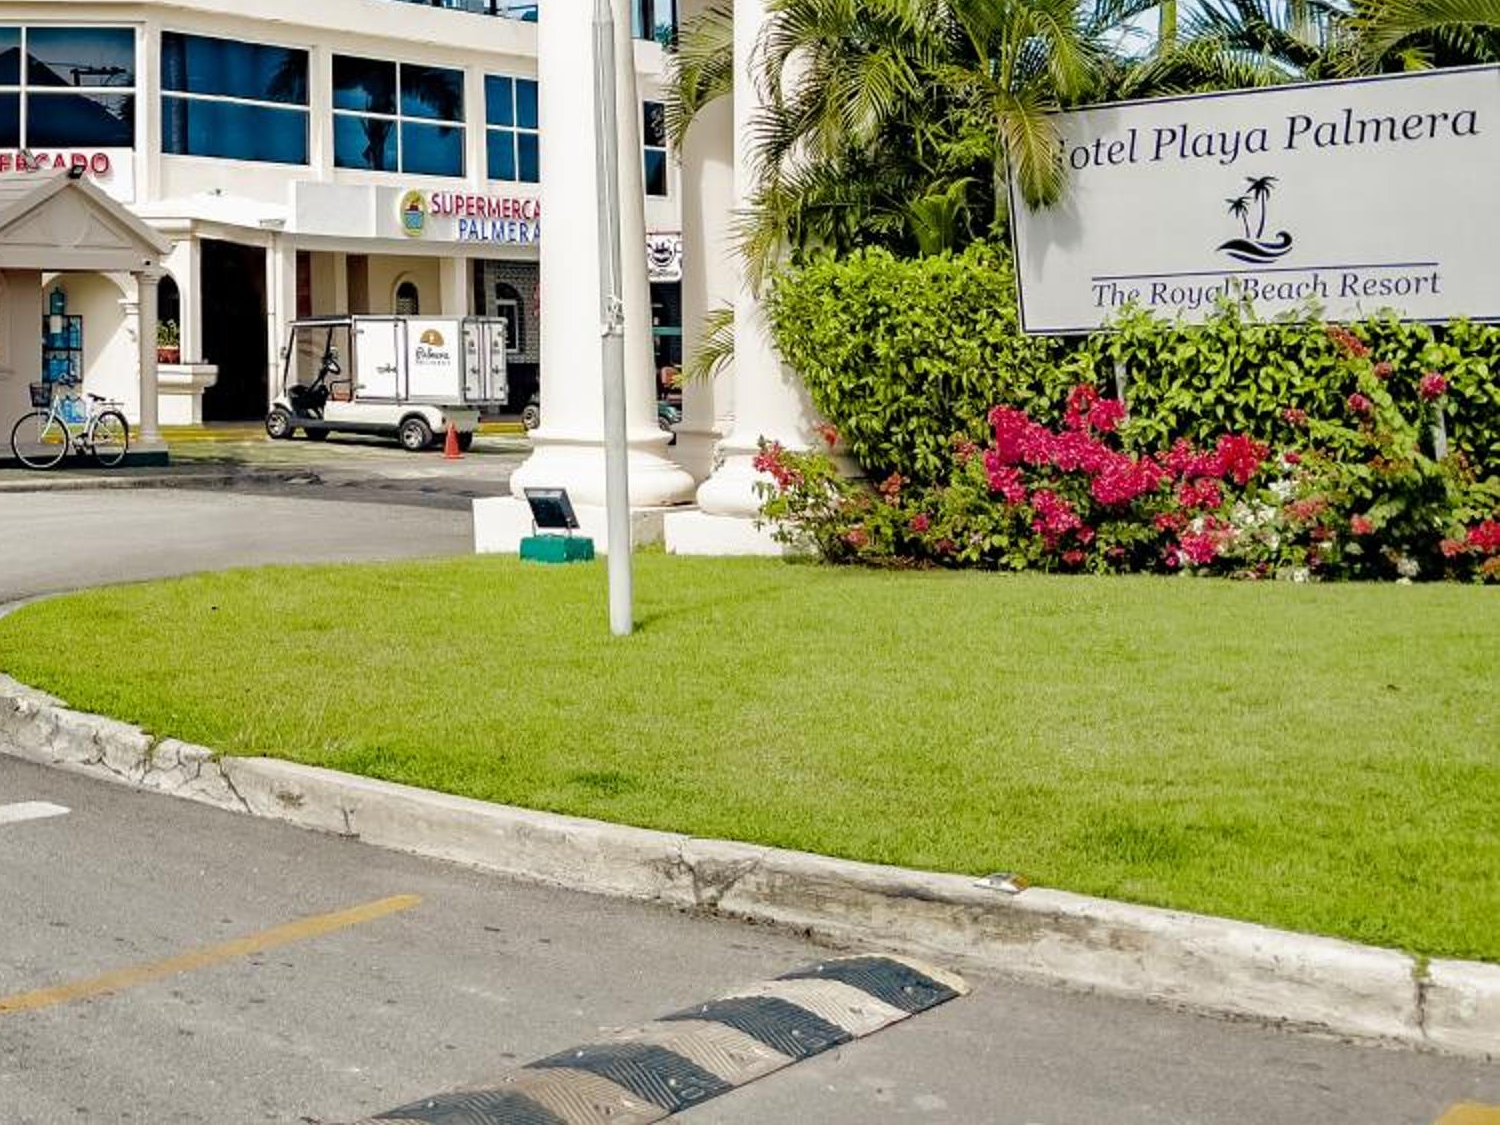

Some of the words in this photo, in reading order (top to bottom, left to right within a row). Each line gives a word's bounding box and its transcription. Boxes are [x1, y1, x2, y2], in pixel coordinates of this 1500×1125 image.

[1056, 128, 1137, 170] otel
[1150, 124, 1269, 165] Playa
[1283, 108, 1480, 150] Palmera
[459, 218, 540, 243] PALMERA
[1092, 282, 1140, 307] The
[1150, 277, 1229, 309] Royal
[1240, 273, 1329, 302] Beach
[1338, 271, 1441, 298] Resort
